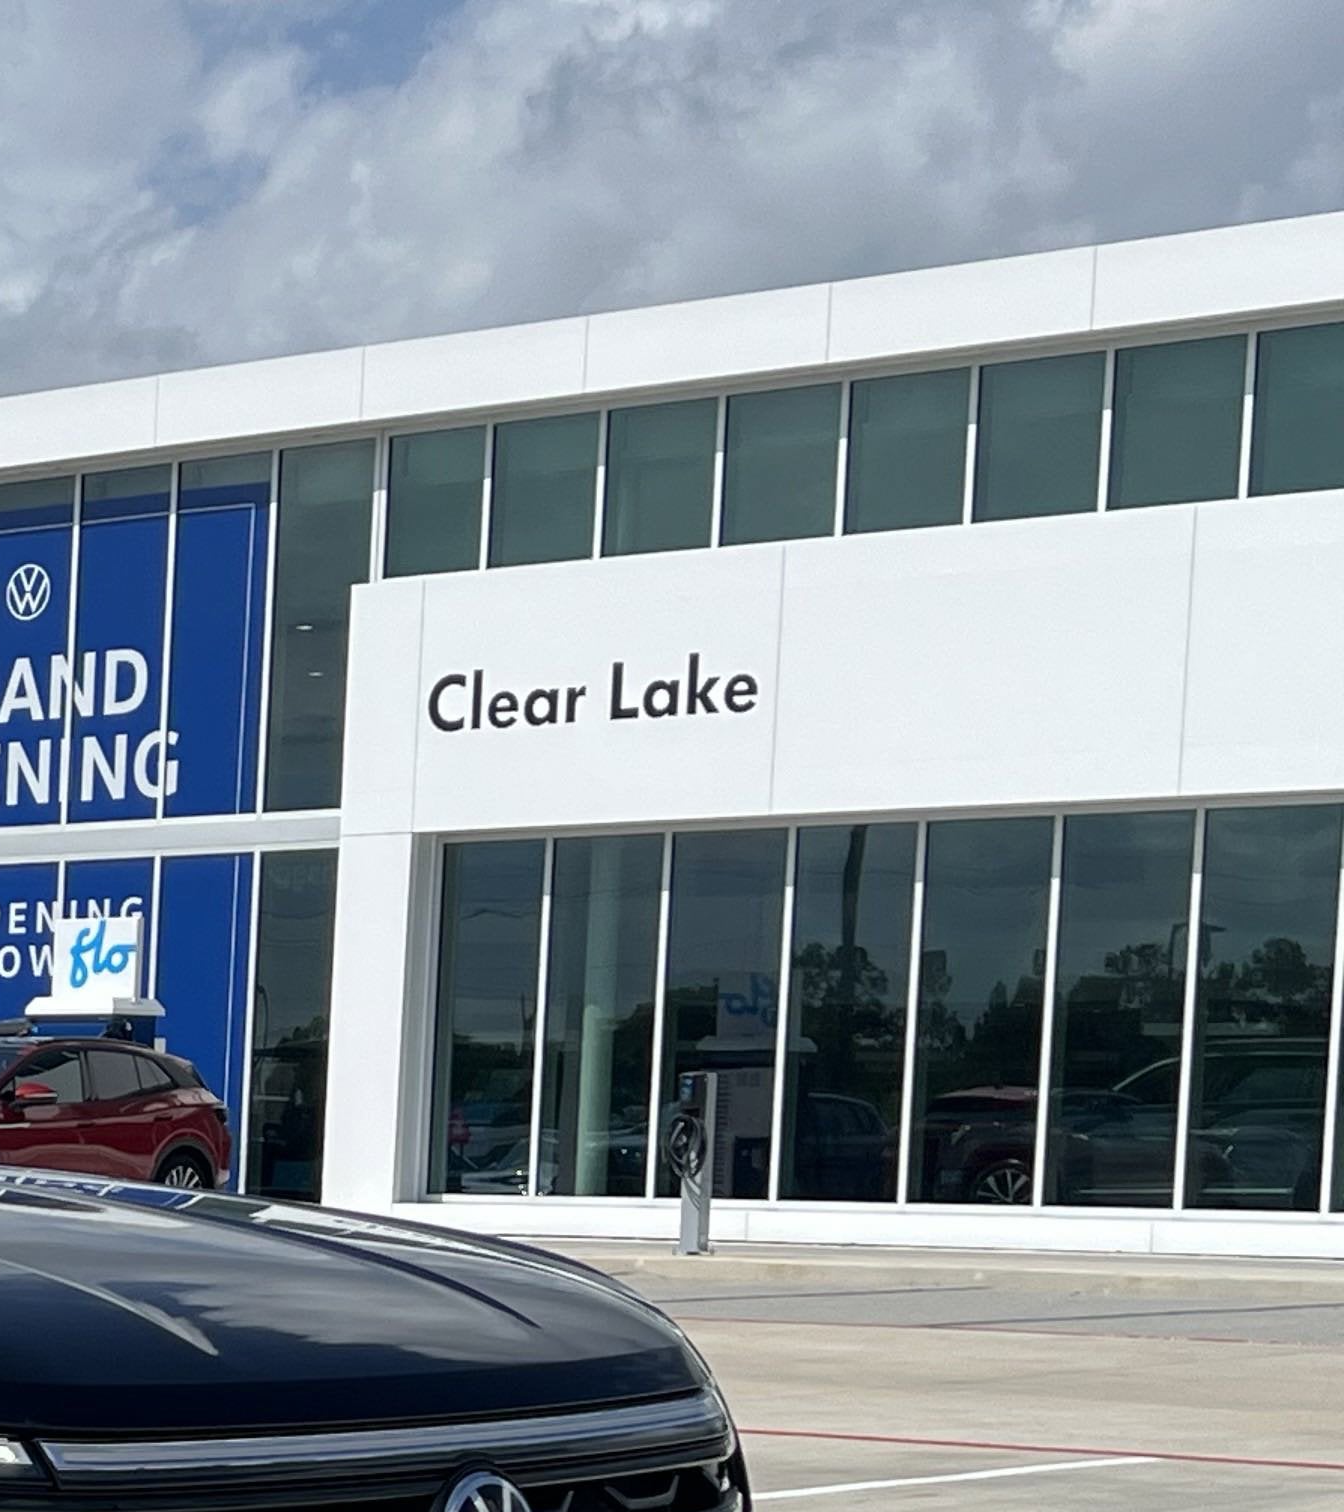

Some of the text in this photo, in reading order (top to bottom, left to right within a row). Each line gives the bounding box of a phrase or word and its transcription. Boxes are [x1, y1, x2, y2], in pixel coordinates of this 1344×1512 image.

[428, 652, 759, 733] Clear Lake
[69, 918, 139, 989] flo
